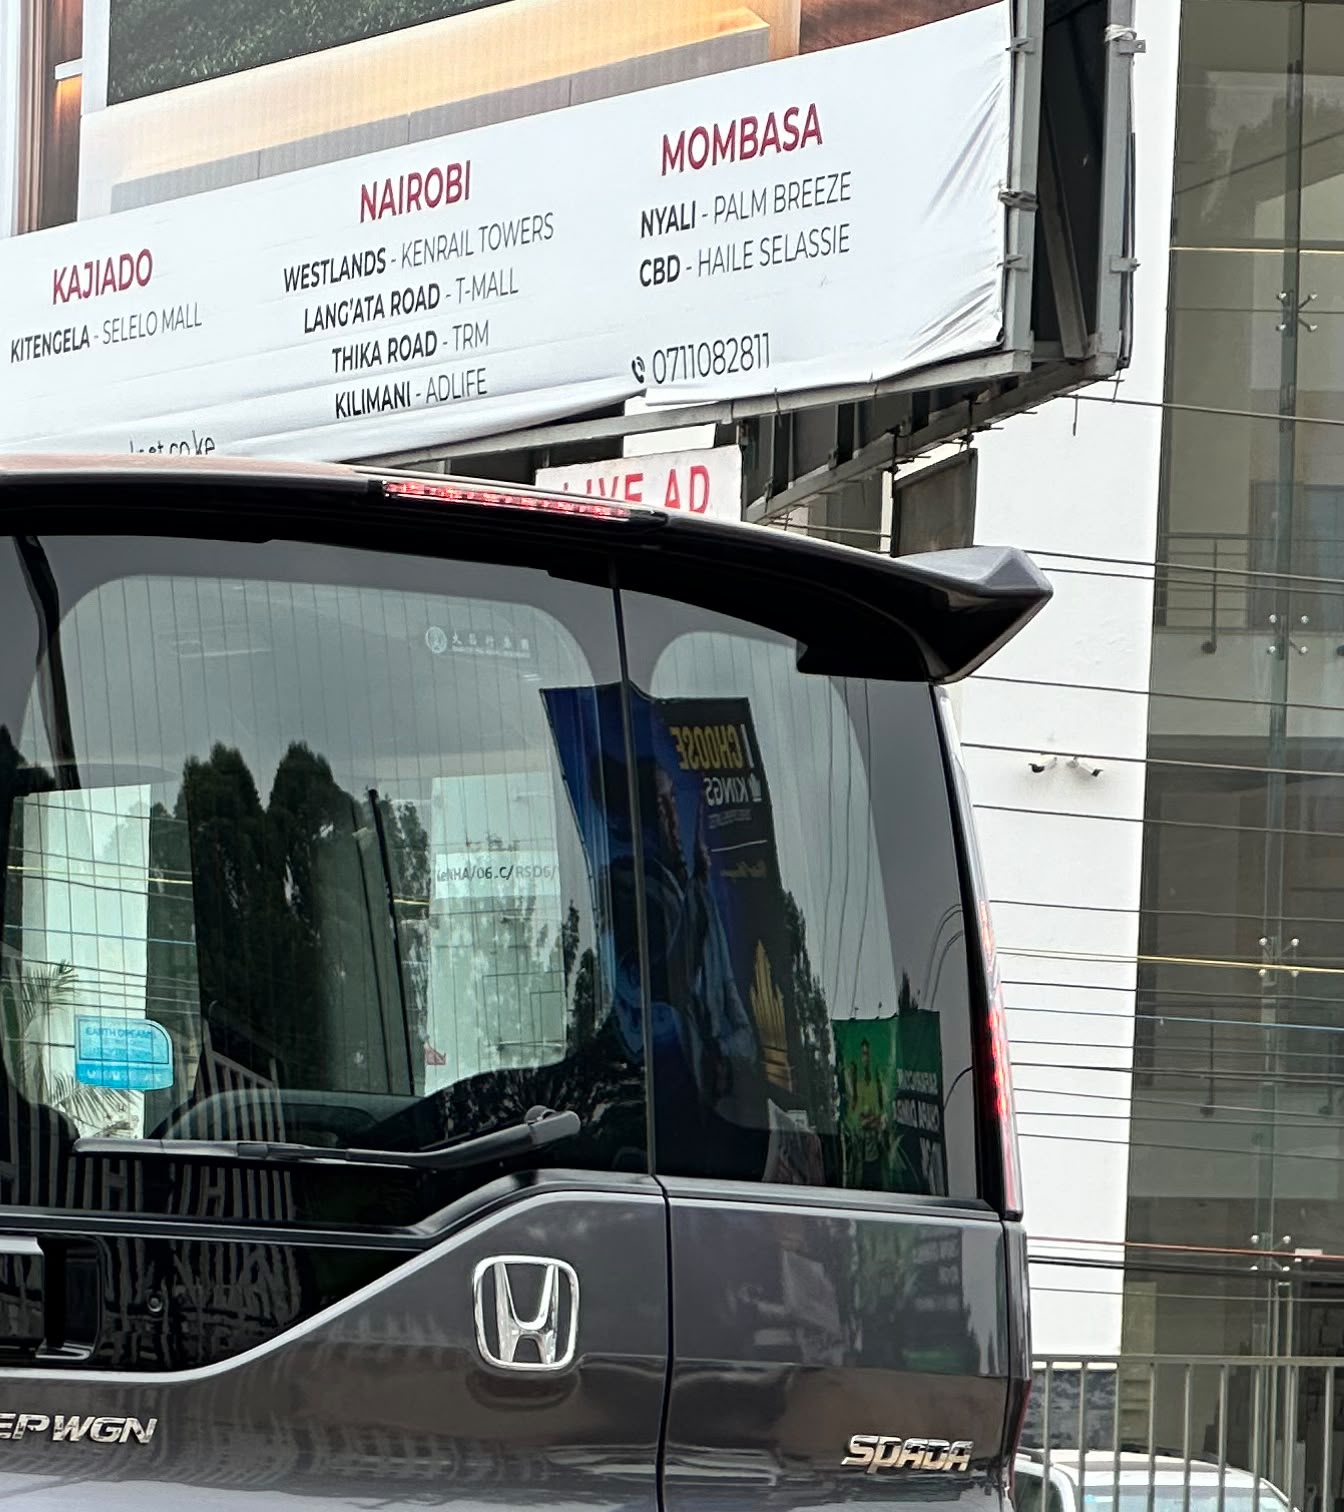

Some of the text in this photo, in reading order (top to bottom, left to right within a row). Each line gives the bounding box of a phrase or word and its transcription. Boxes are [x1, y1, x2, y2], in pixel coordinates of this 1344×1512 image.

[662, 103, 823, 176] MOMBASA
[360, 160, 470, 223] NAIROBI
[641, 200, 696, 238] NYALI
[714, 187, 766, 224] PALM
[774, 171, 851, 214] BREEZE
[53, 249, 152, 305] KAJIADO
[284, 247, 386, 293] WESTLANDS
[402, 224, 474, 268] KENRAIL
[478, 212, 553, 252] TOWERS
[640, 255, 680, 287] CBD
[699, 240, 753, 277] HAILE
[760, 223, 850, 266] SELASSIE
[305, 294, 385, 334] LANG'ATA
[390, 283, 440, 317] ROAD
[456, 268, 518, 304] T-MALL
[11, 325, 90, 363] KITENGELA
[103, 311, 157, 344] SELELO
[162, 303, 202, 332] MALL
[332, 340, 382, 373] THIKA
[388, 331, 437, 364] ROAD
[452, 320, 488, 351] TRM
[653, 333, 769, 384] 0711082811
[336, 381, 411, 419] KILIMANI
[425, 368, 488, 404] ADLIFE
[664, 465, 710, 514] AD
